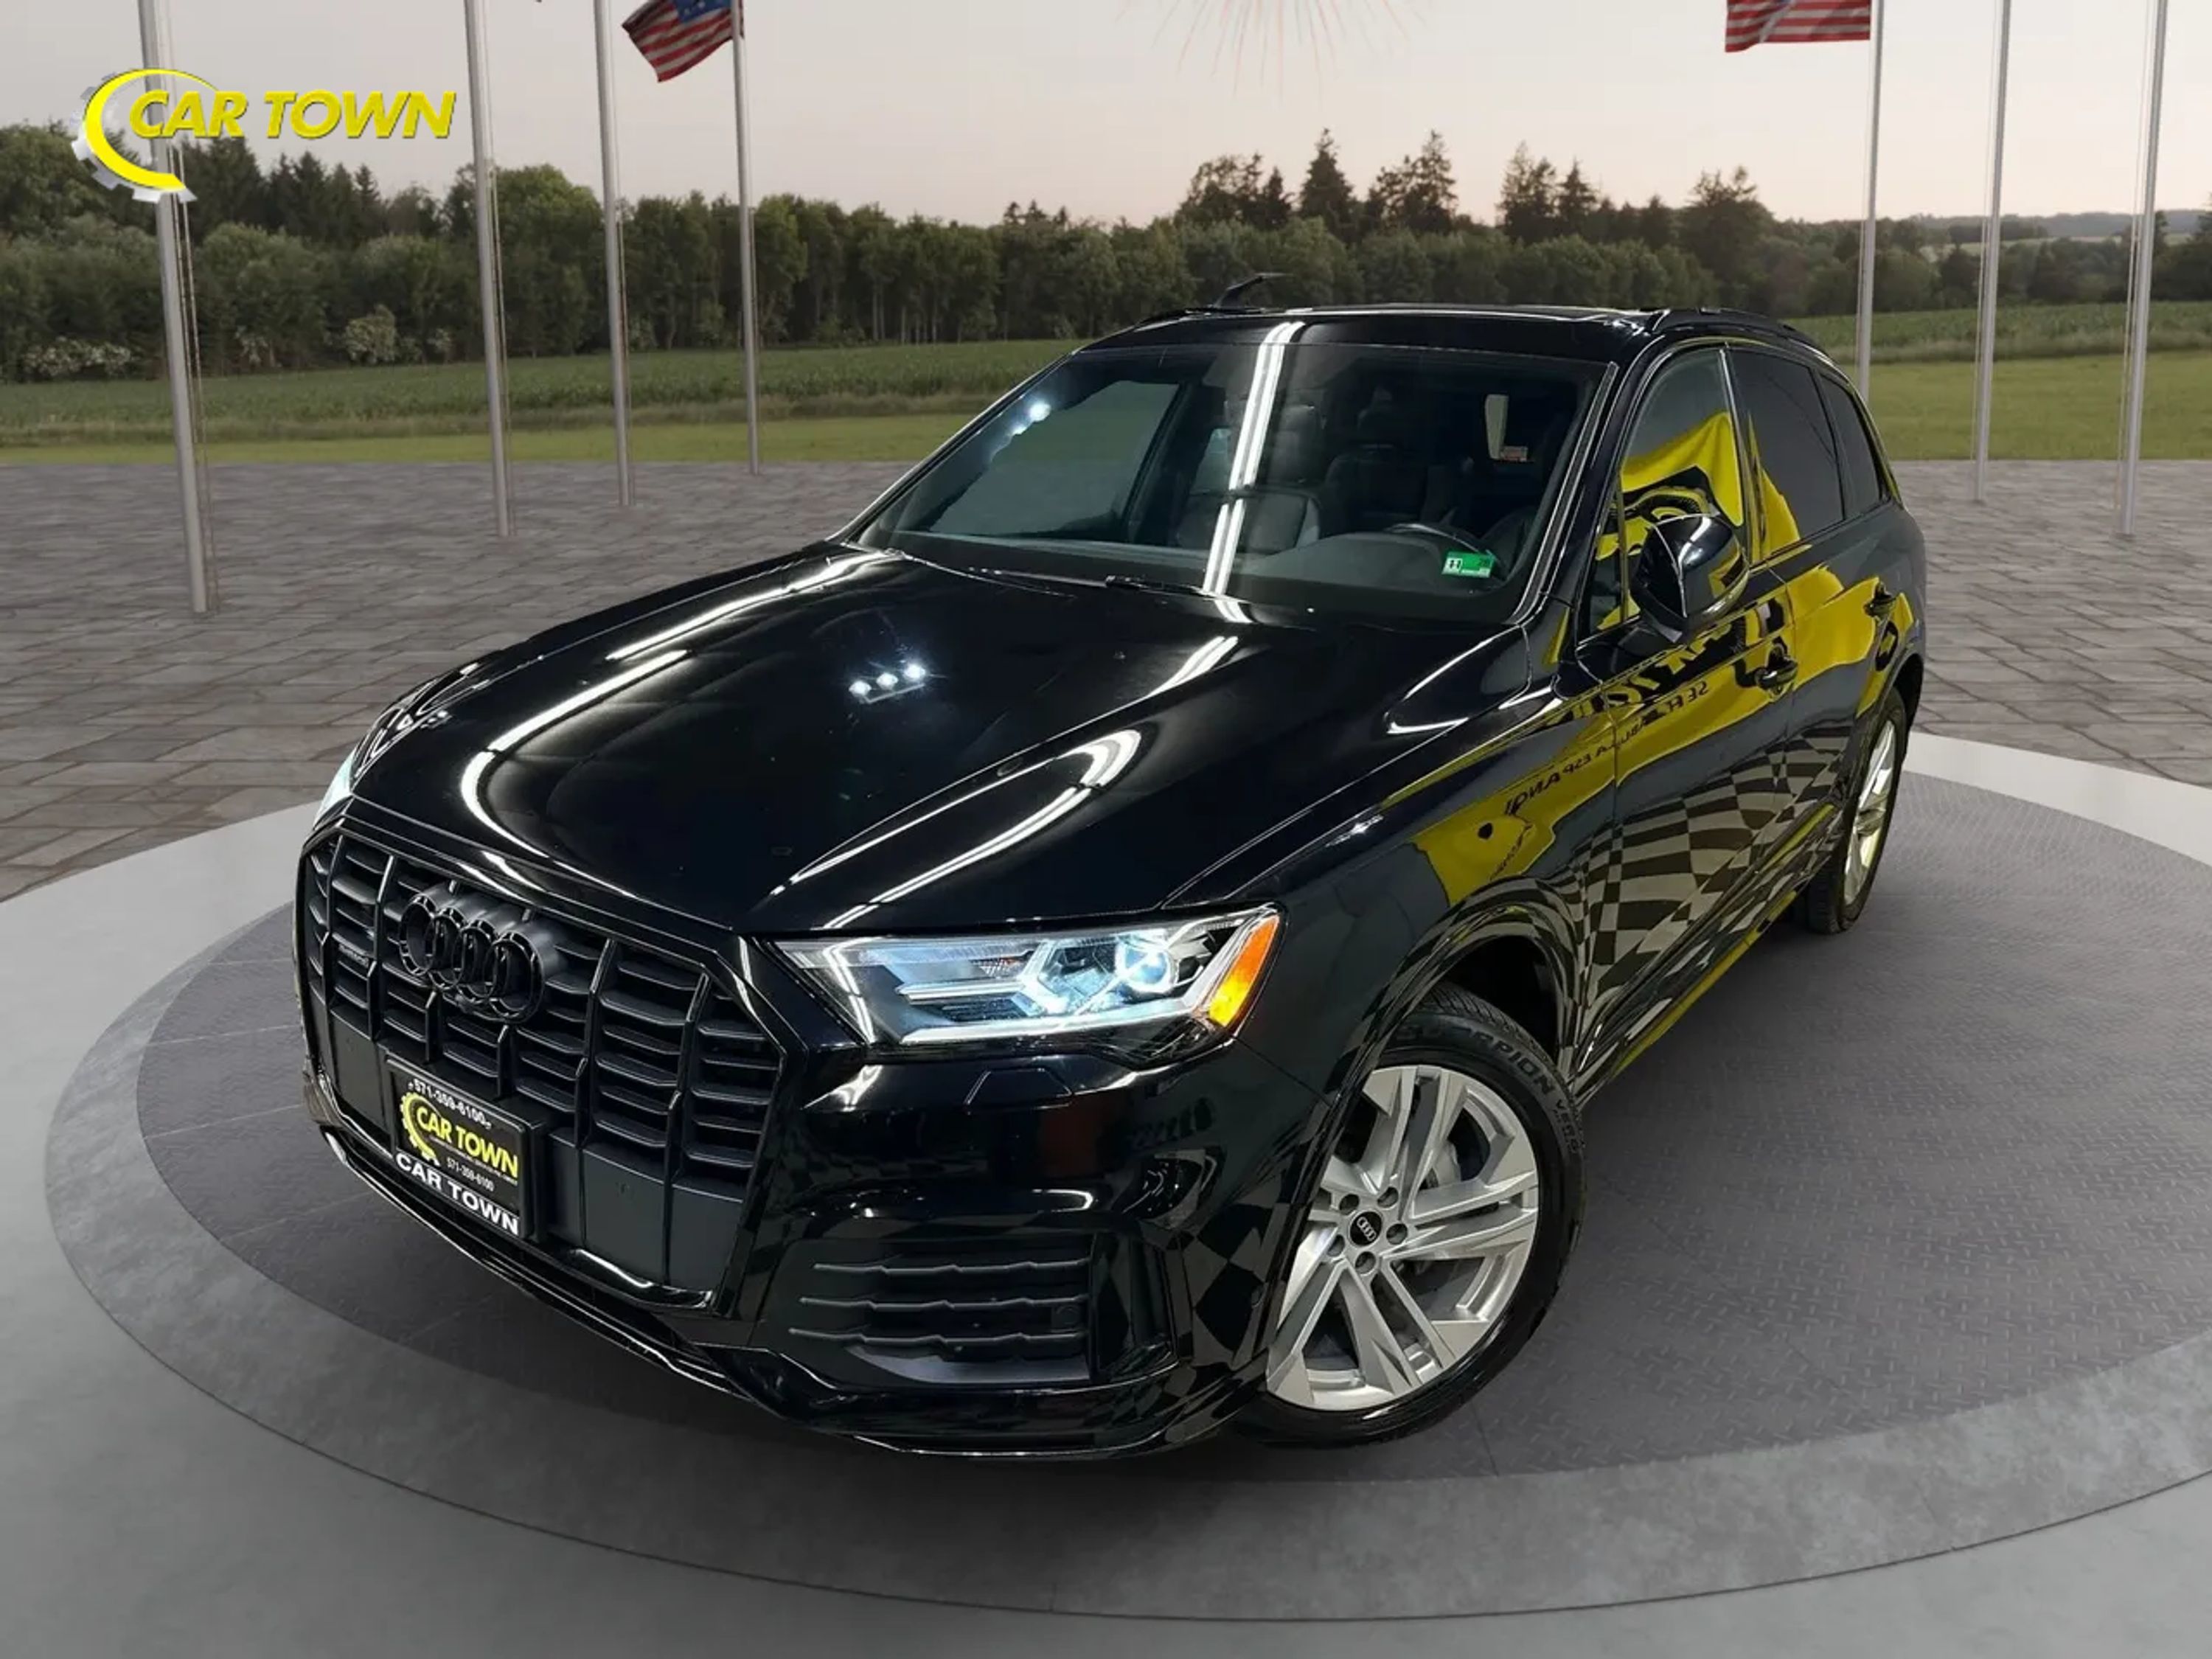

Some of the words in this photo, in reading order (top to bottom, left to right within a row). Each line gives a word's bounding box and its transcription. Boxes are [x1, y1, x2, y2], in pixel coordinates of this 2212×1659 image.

[416, 1106, 452, 1143] CAR
[455, 1125, 518, 1178] TOWN
[396, 1152, 442, 1190] CAR
[448, 1180, 518, 1235] TOWN
